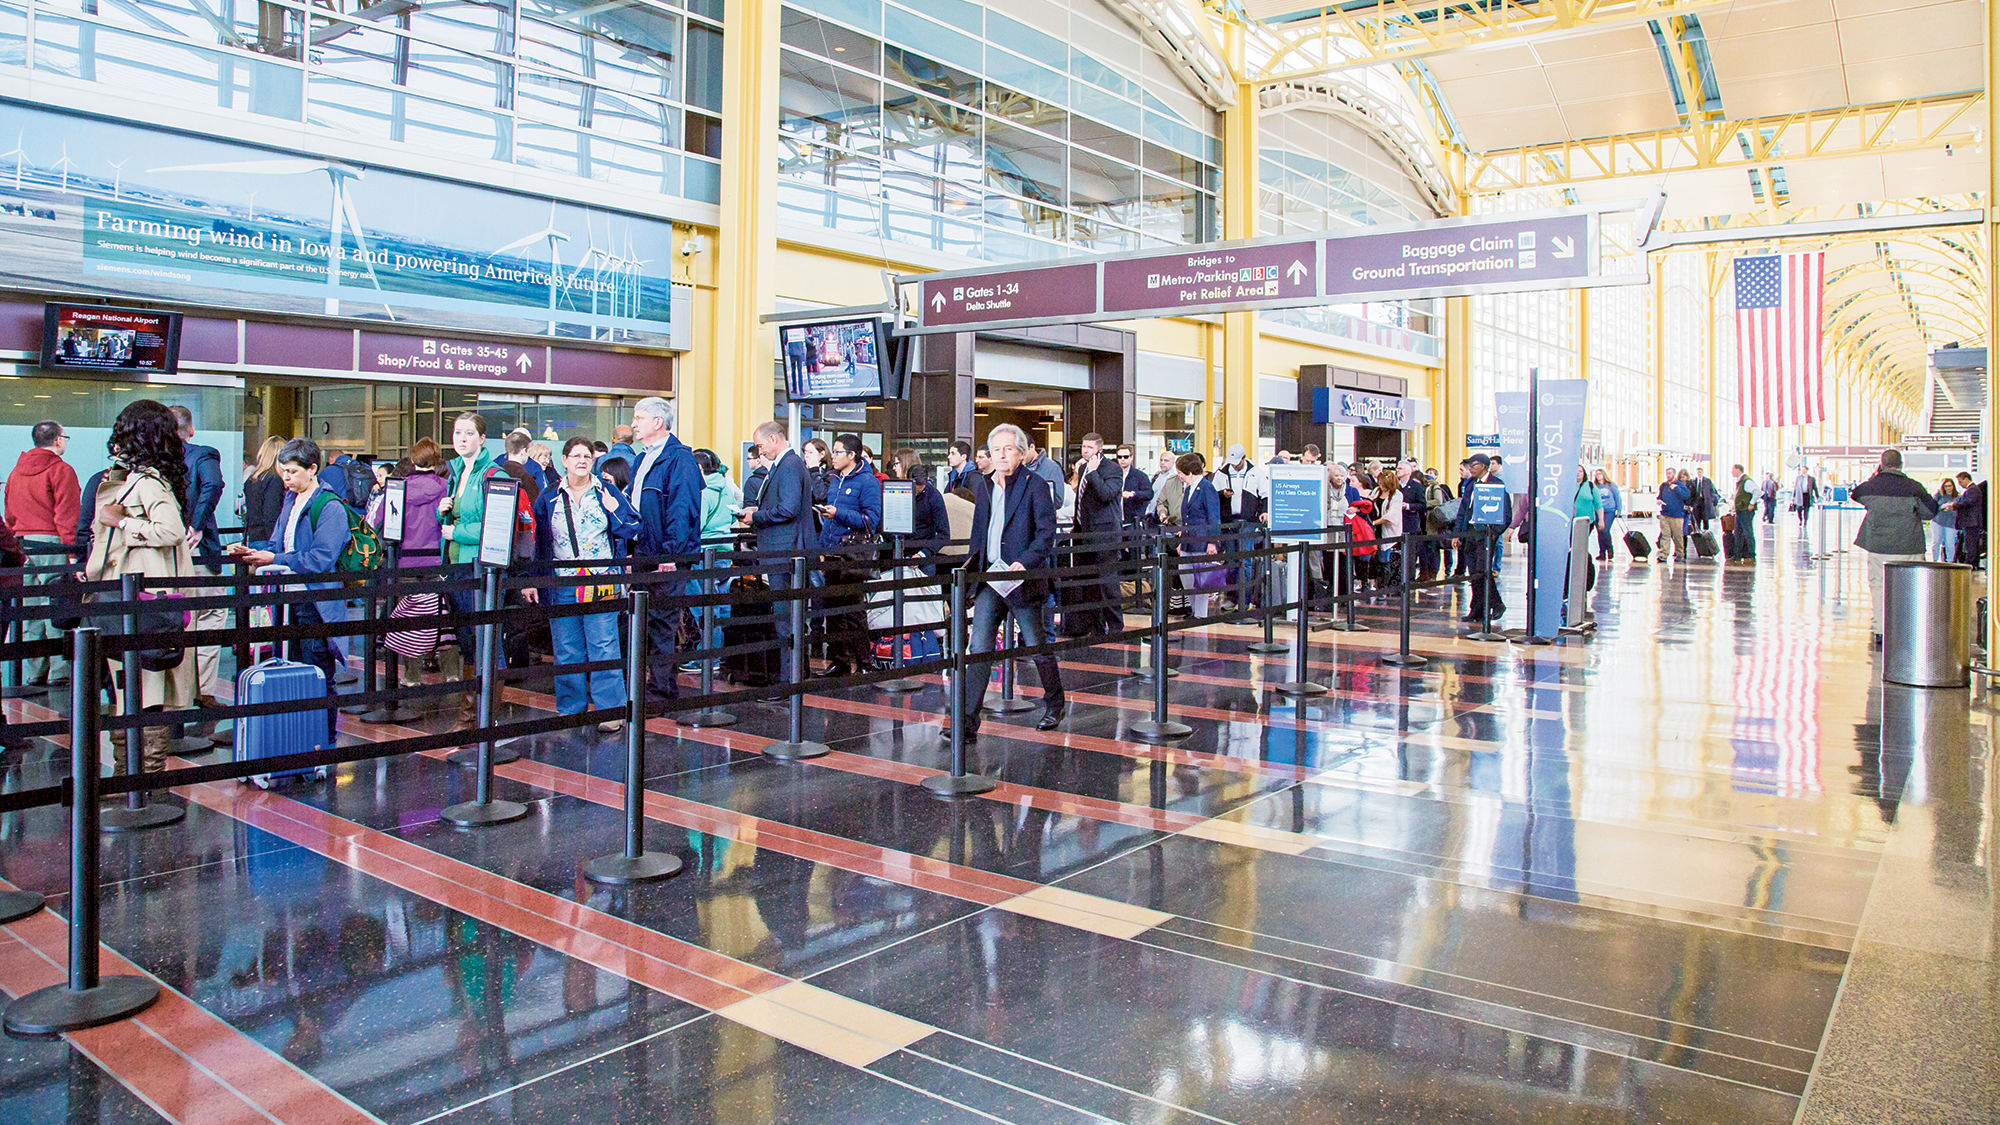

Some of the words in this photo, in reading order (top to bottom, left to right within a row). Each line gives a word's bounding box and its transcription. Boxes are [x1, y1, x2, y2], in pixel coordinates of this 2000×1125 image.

[96, 210, 201, 246] Farming
[208, 228, 264, 250] wind
[270, 233, 292, 254] in
[298, 238, 348, 260] Iowa
[352, 248, 390, 266] and
[394, 256, 480, 280] powering
[484, 263, 562, 287] America's
[1402, 241, 1466, 260] Baggage
[1469, 236, 1514, 252] Claim
[96, 240, 134, 252] Siemens
[135, 243, 142, 252] is
[144, 244, 176, 259] helping
[178, 248, 198, 260] wind
[200, 252, 231, 264] become
[232, 256, 238, 264] a
[238, 256, 278, 270] significant
[279, 262, 294, 273] part
[296, 262, 304, 272] of
[305, 263, 318, 273] the
[319, 264, 332, 274] U.S.
[334, 268, 359, 279] energy
[1188, 256, 1222, 268] Bridges
[1226, 256, 1235, 264] to
[1352, 263, 1405, 281] Ground
[1408, 256, 1514, 276] Transportation
[96, 263, 191, 282] siemens.com/windsong
[1161, 271, 1239, 286] Metro/Parking
[1241, 270, 1250, 280] A
[1254, 268, 1262, 279] B
[1267, 266, 1277, 277] C
[966, 287, 994, 298] Gates
[996, 282, 1019, 295] 1-34
[1180, 290, 1197, 301] Pet
[1201, 286, 1232, 299] Relief
[1236, 286, 1264, 297] Area
[966, 300, 985, 311] Delta
[986, 299, 1011, 309] Shuttle
[72, 312, 100, 322] Reagan
[102, 314, 132, 323] National
[134, 316, 159, 325] Airport
[440, 343, 473, 356] Gates
[477, 346, 508, 359] 35-45
[377, 354, 440, 369] Shop/Food
[444, 359, 454, 370] &
[458, 360, 508, 376] Beverage
[1543, 420, 1563, 458] TSA
[1543, 464, 1563, 496] Pre
